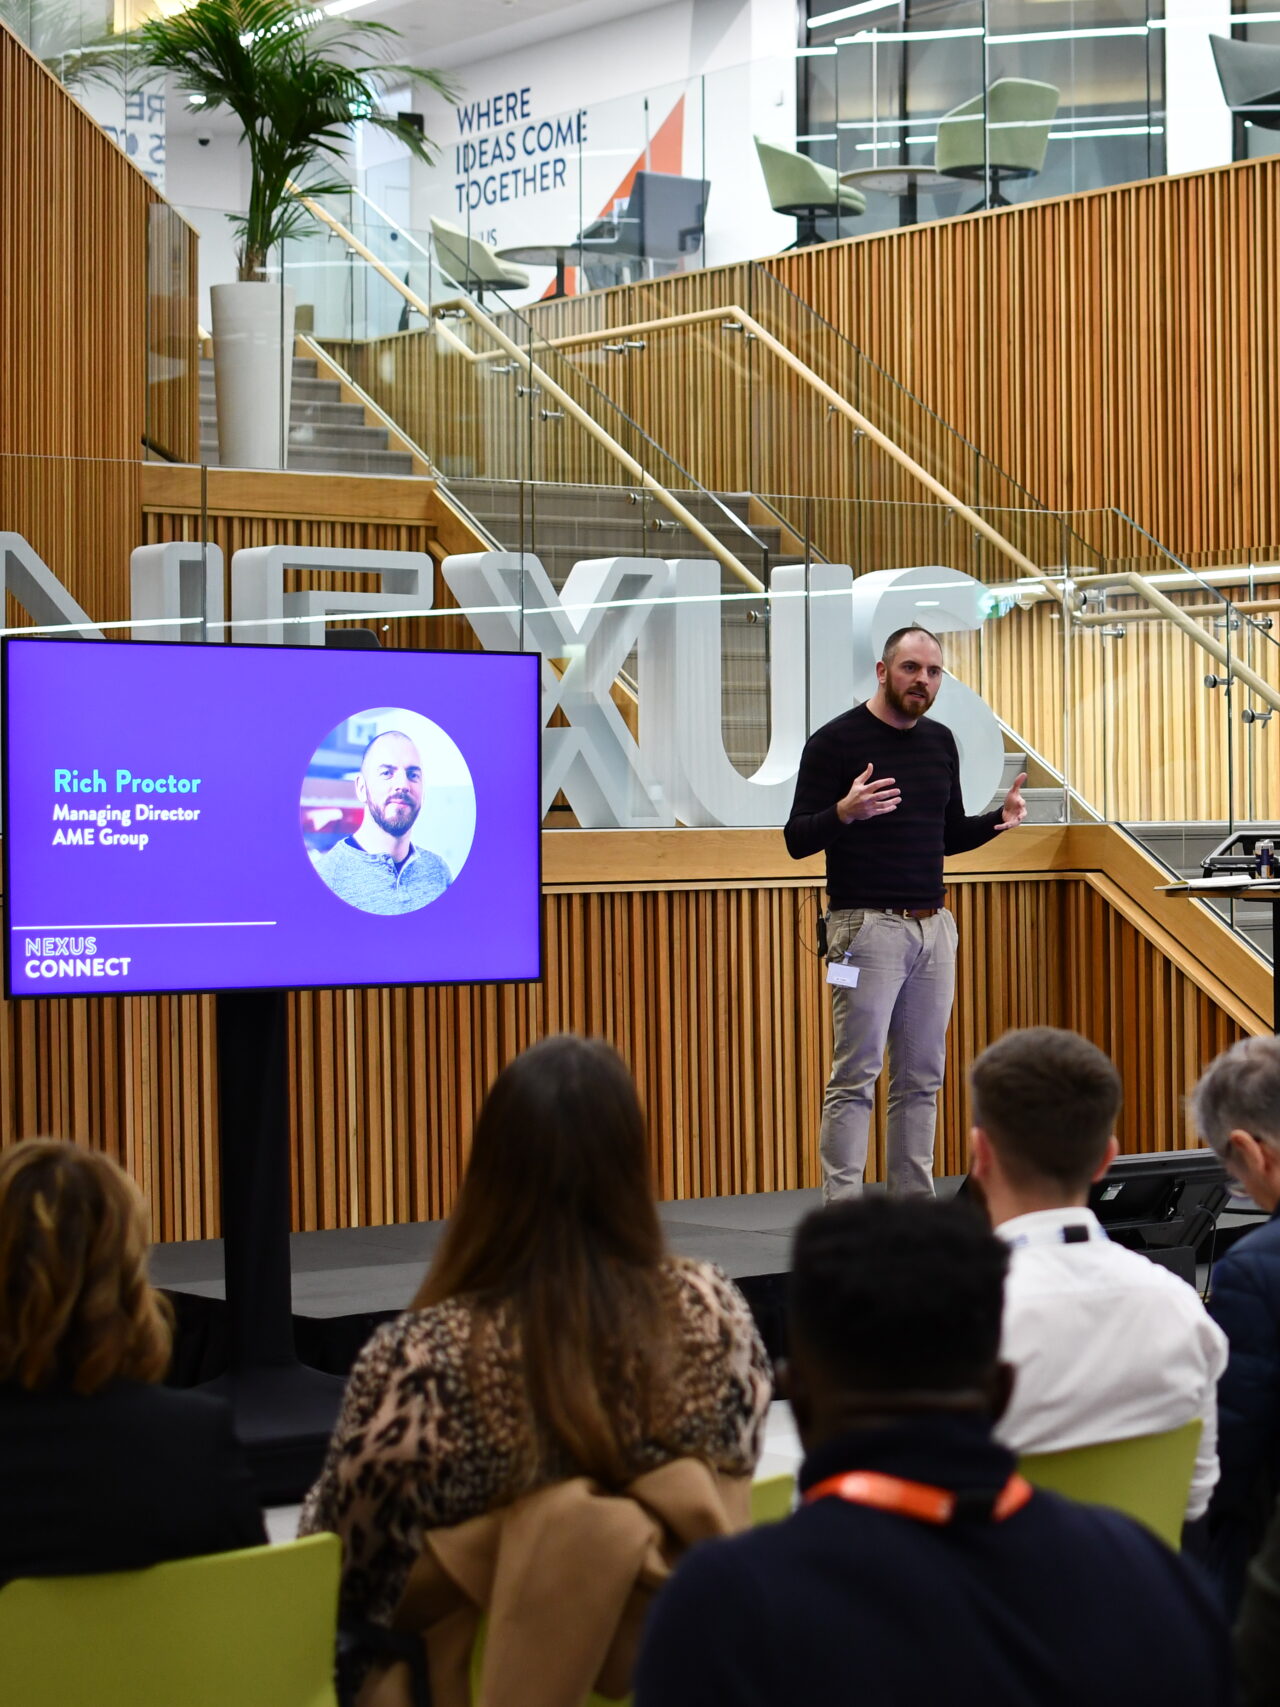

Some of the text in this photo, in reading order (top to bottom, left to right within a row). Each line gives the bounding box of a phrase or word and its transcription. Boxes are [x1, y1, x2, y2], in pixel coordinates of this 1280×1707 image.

[457, 88, 531, 135] WHERE
[456, 110, 587, 175] IDEAS COME
[456, 158, 566, 213] TOGETHER
[54, 768, 201, 793] Rich Proctor
[52, 803, 200, 827] Managing Director
[52, 828, 149, 851] AME Group
[25, 936, 97, 957] NEXUS
[25, 957, 131, 978] CONNECT
